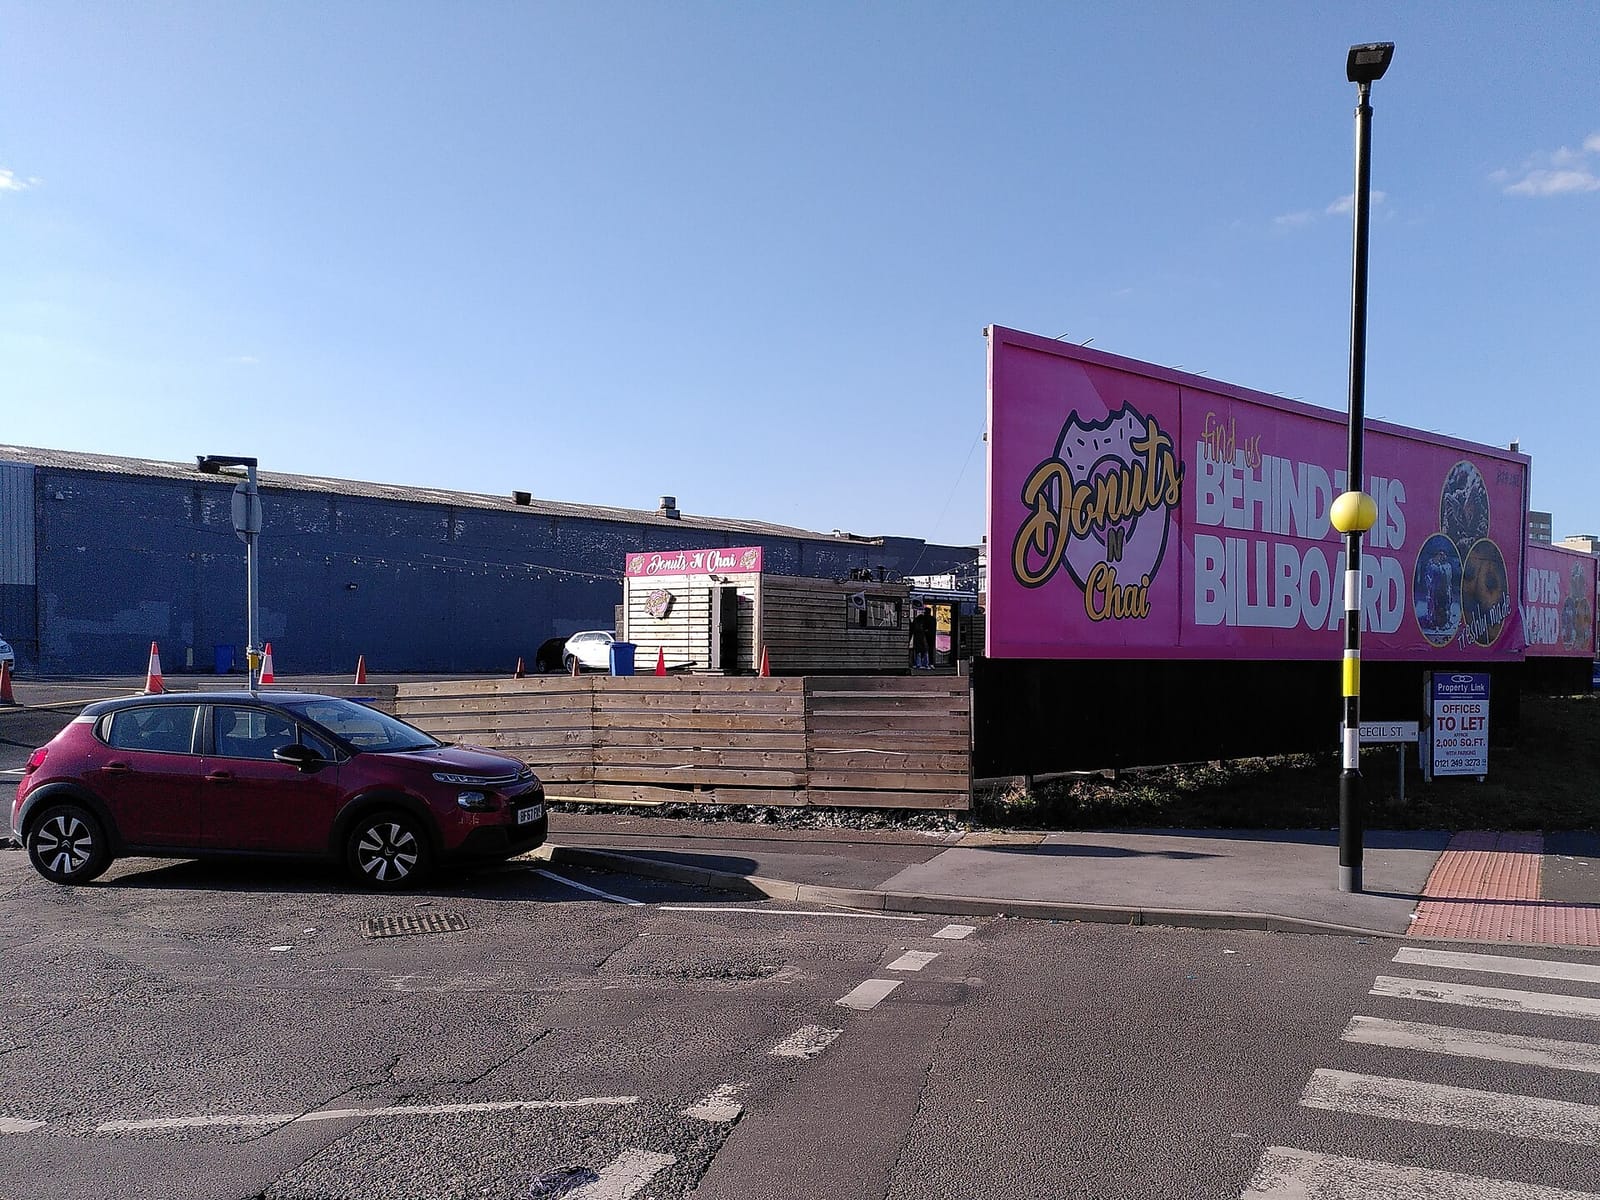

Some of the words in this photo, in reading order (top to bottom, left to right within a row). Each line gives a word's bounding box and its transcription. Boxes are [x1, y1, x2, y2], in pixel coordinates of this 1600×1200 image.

[1201, 410, 1236, 466] find
[1244, 433, 1262, 469] us
[1012, 416, 1185, 586] Donuts
[1196, 440, 1333, 541] BEHIND
[1107, 528, 1125, 562] N
[646, 551, 688, 575] Donuts
[690, 552, 705, 568] N
[706, 550, 737, 572] Chai
[1084, 562, 1151, 622] Chai
[1194, 533, 1406, 633] BILLBOARD
[1489, 591, 1511, 627] made
[1437, 683, 1469, 693] Property
[1470, 683, 1485, 691] Link
[1437, 716, 1457, 731] TO
[1460, 716, 1485, 731] LET
[1442, 704, 1481, 714] OFFICES
[1359, 726, 1388, 737] CECIL
[1436, 738, 1458, 748] 2,000
[1460, 738, 1486, 747] SQ.FT.
[1434, 759, 1449, 768] 0121
[1450, 759, 1463, 768] 249
